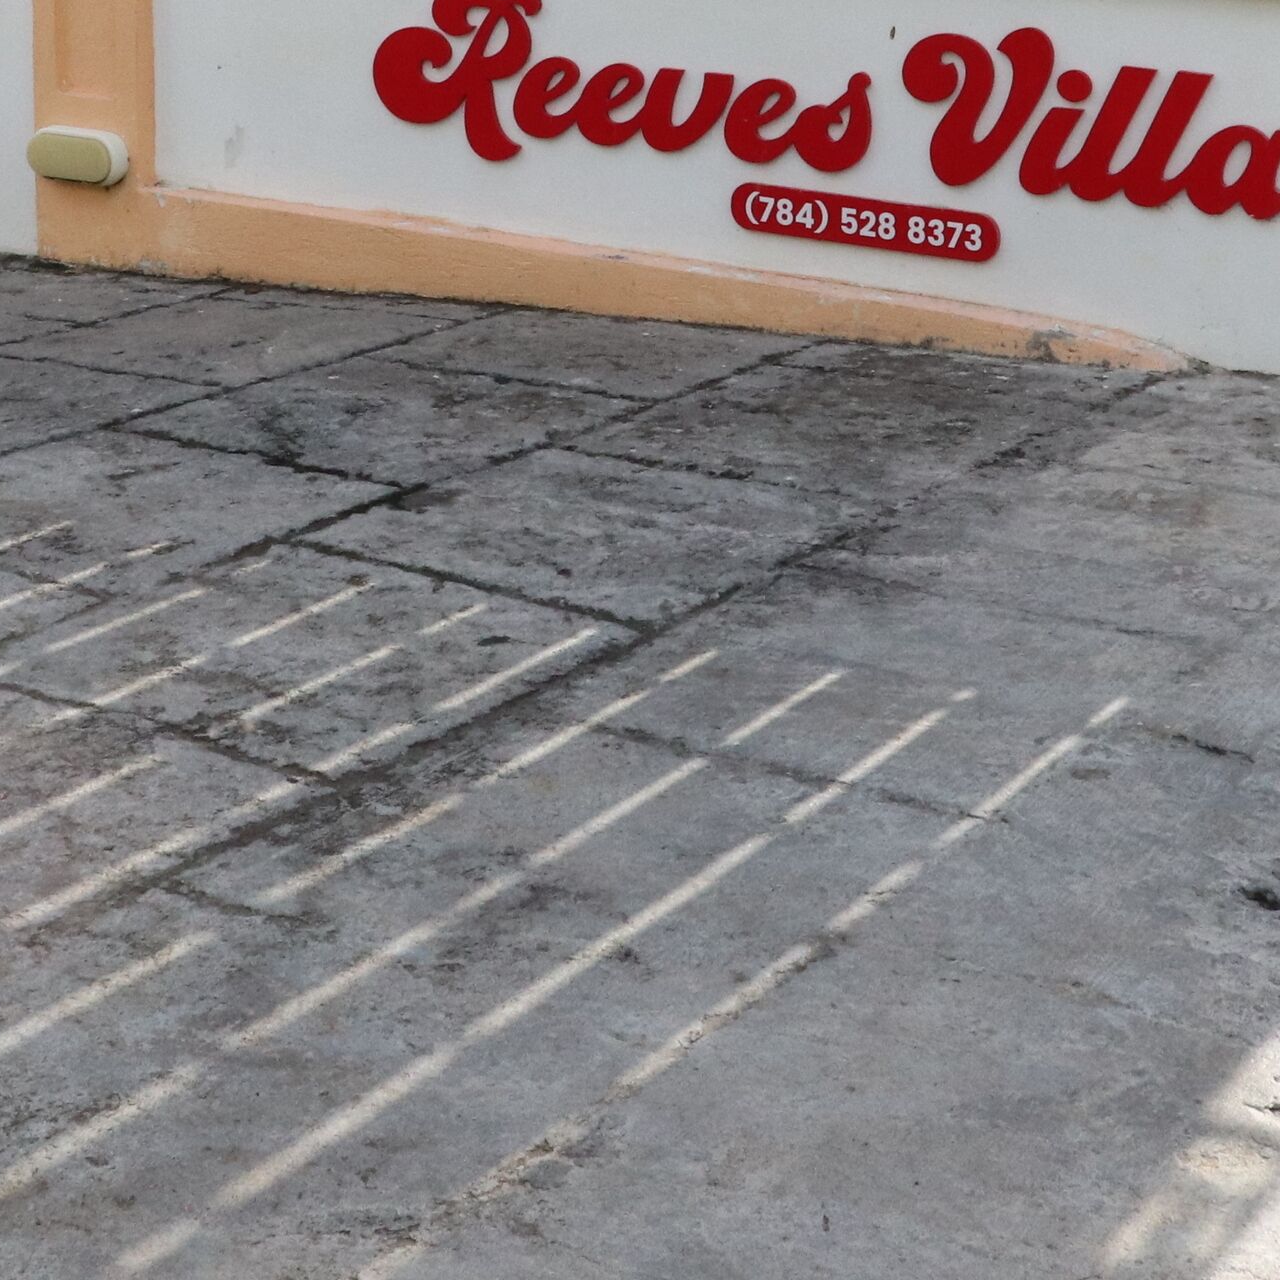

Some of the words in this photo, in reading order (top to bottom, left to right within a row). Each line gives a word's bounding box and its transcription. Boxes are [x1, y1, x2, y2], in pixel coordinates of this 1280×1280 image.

[745, 191, 829, 234] (784)
[841, 207, 896, 241] 528
[907, 216, 983, 252] 8373
